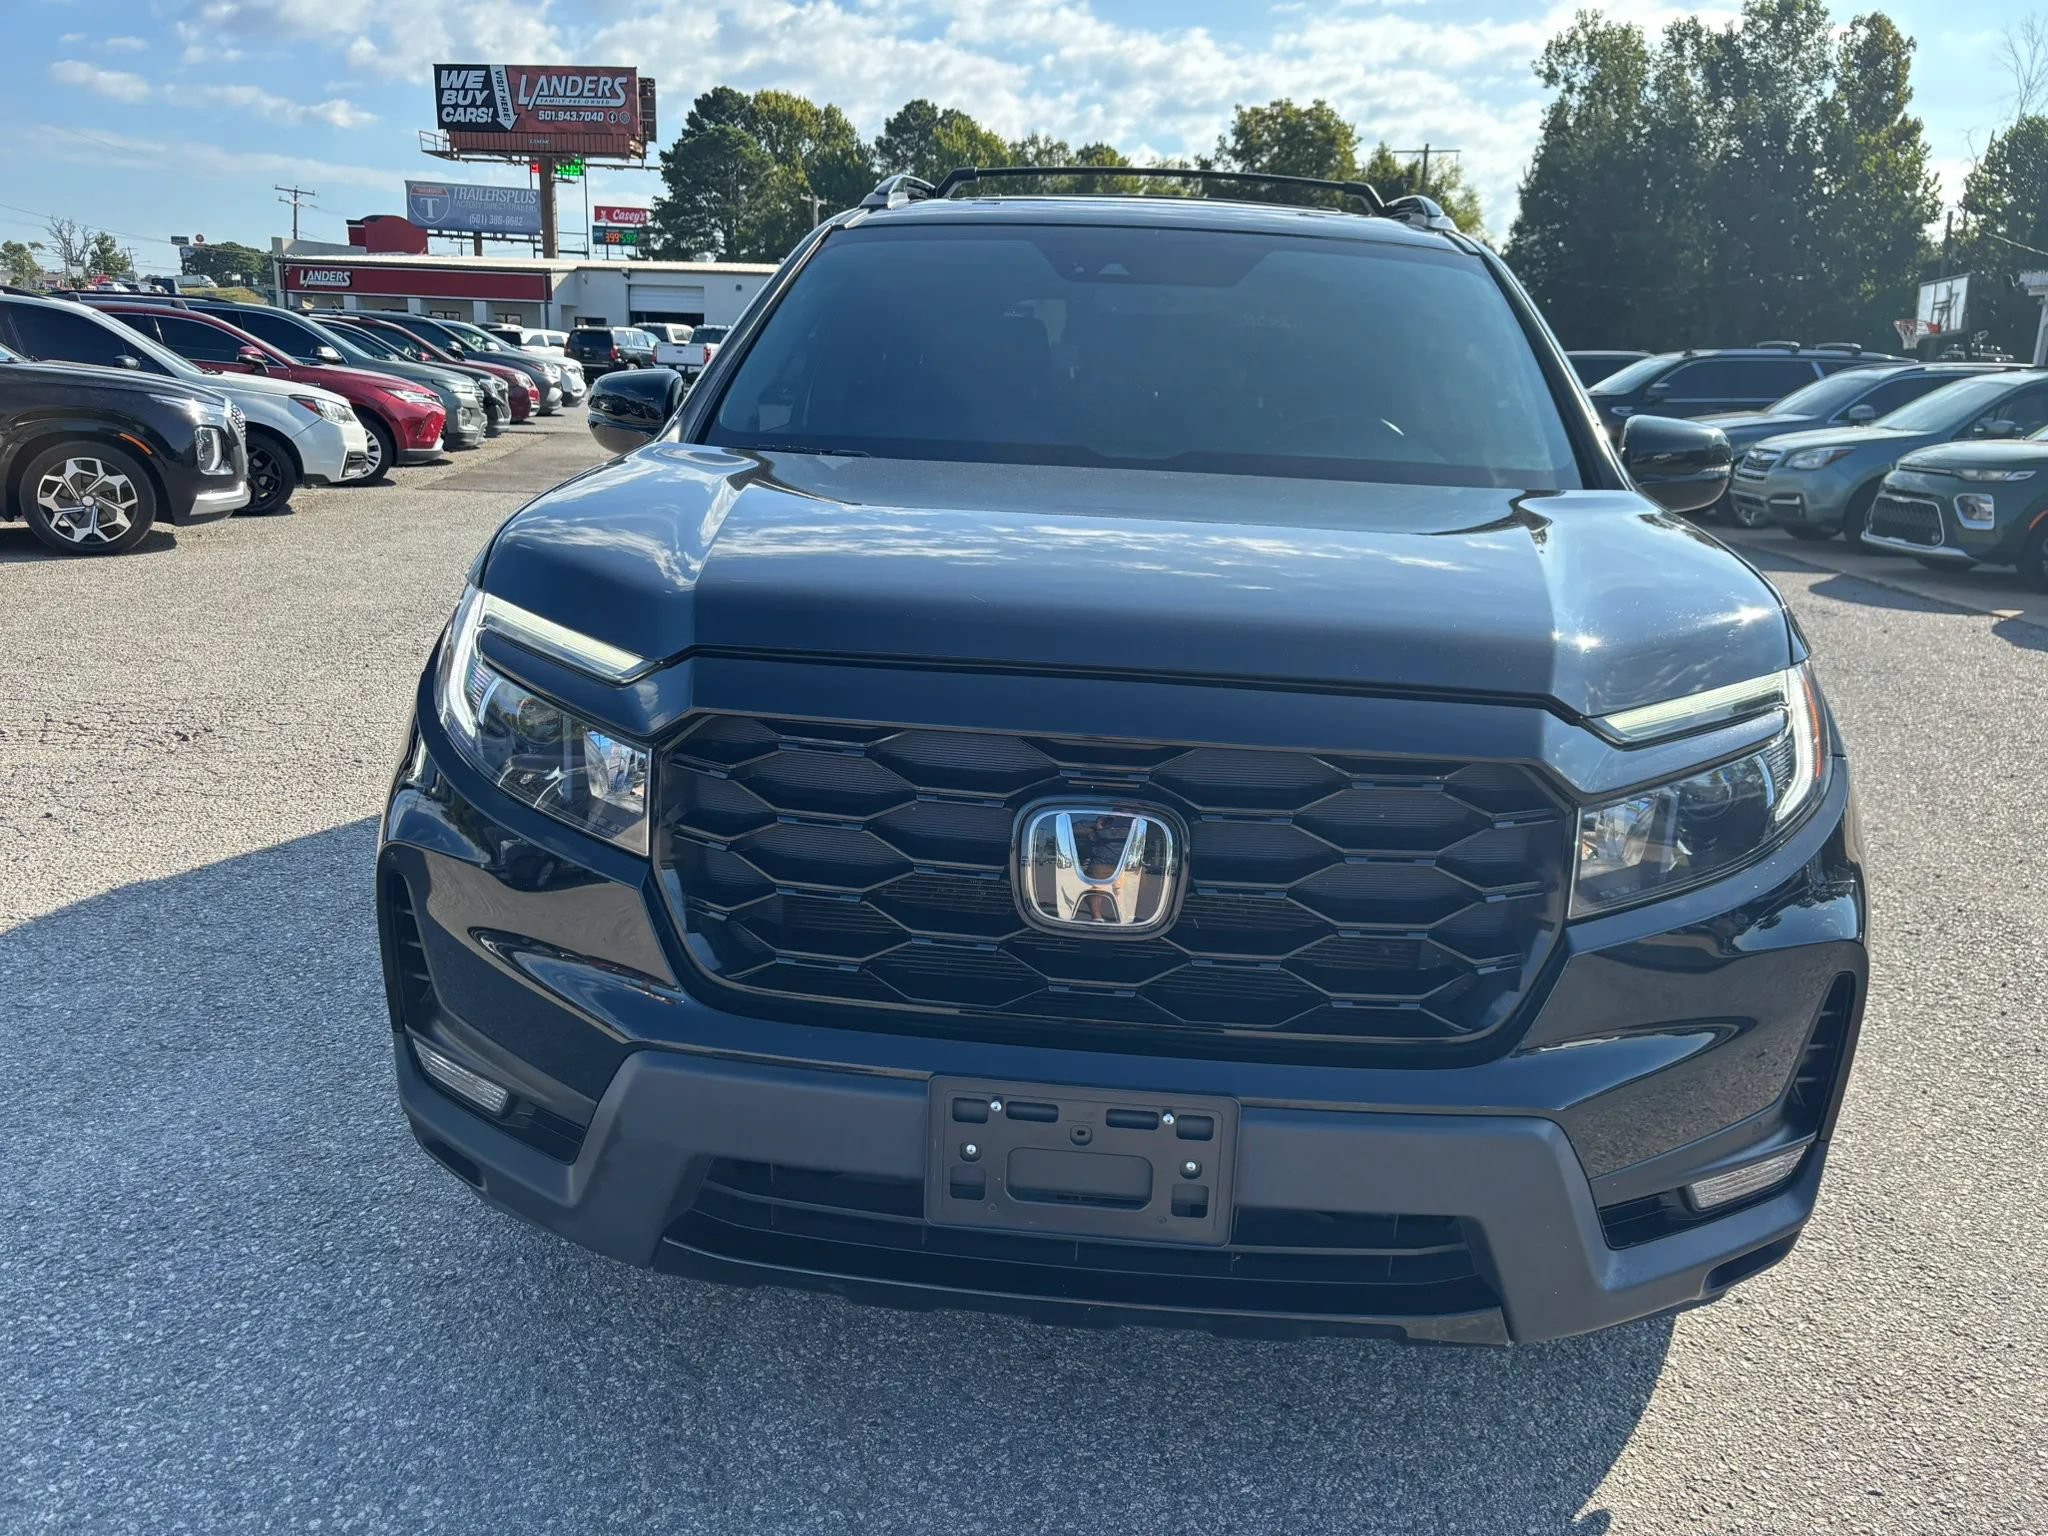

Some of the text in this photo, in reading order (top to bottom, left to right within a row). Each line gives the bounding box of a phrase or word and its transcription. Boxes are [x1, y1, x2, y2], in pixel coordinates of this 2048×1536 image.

[440, 70, 486, 89] WE
[441, 90, 490, 106] BUY
[495, 70, 511, 122] VISIT HERE!
[518, 74, 628, 110] LANDERS
[441, 106, 494, 123] CARS!
[538, 110, 604, 122] 501.943.7040
[452, 199, 482, 209] FACTORY
[453, 186, 537, 204] TRAILERSPLUS
[420, 197, 440, 219] T
[612, 208, 645, 223] Casey's
[299, 269, 351, 288] LANDERS
